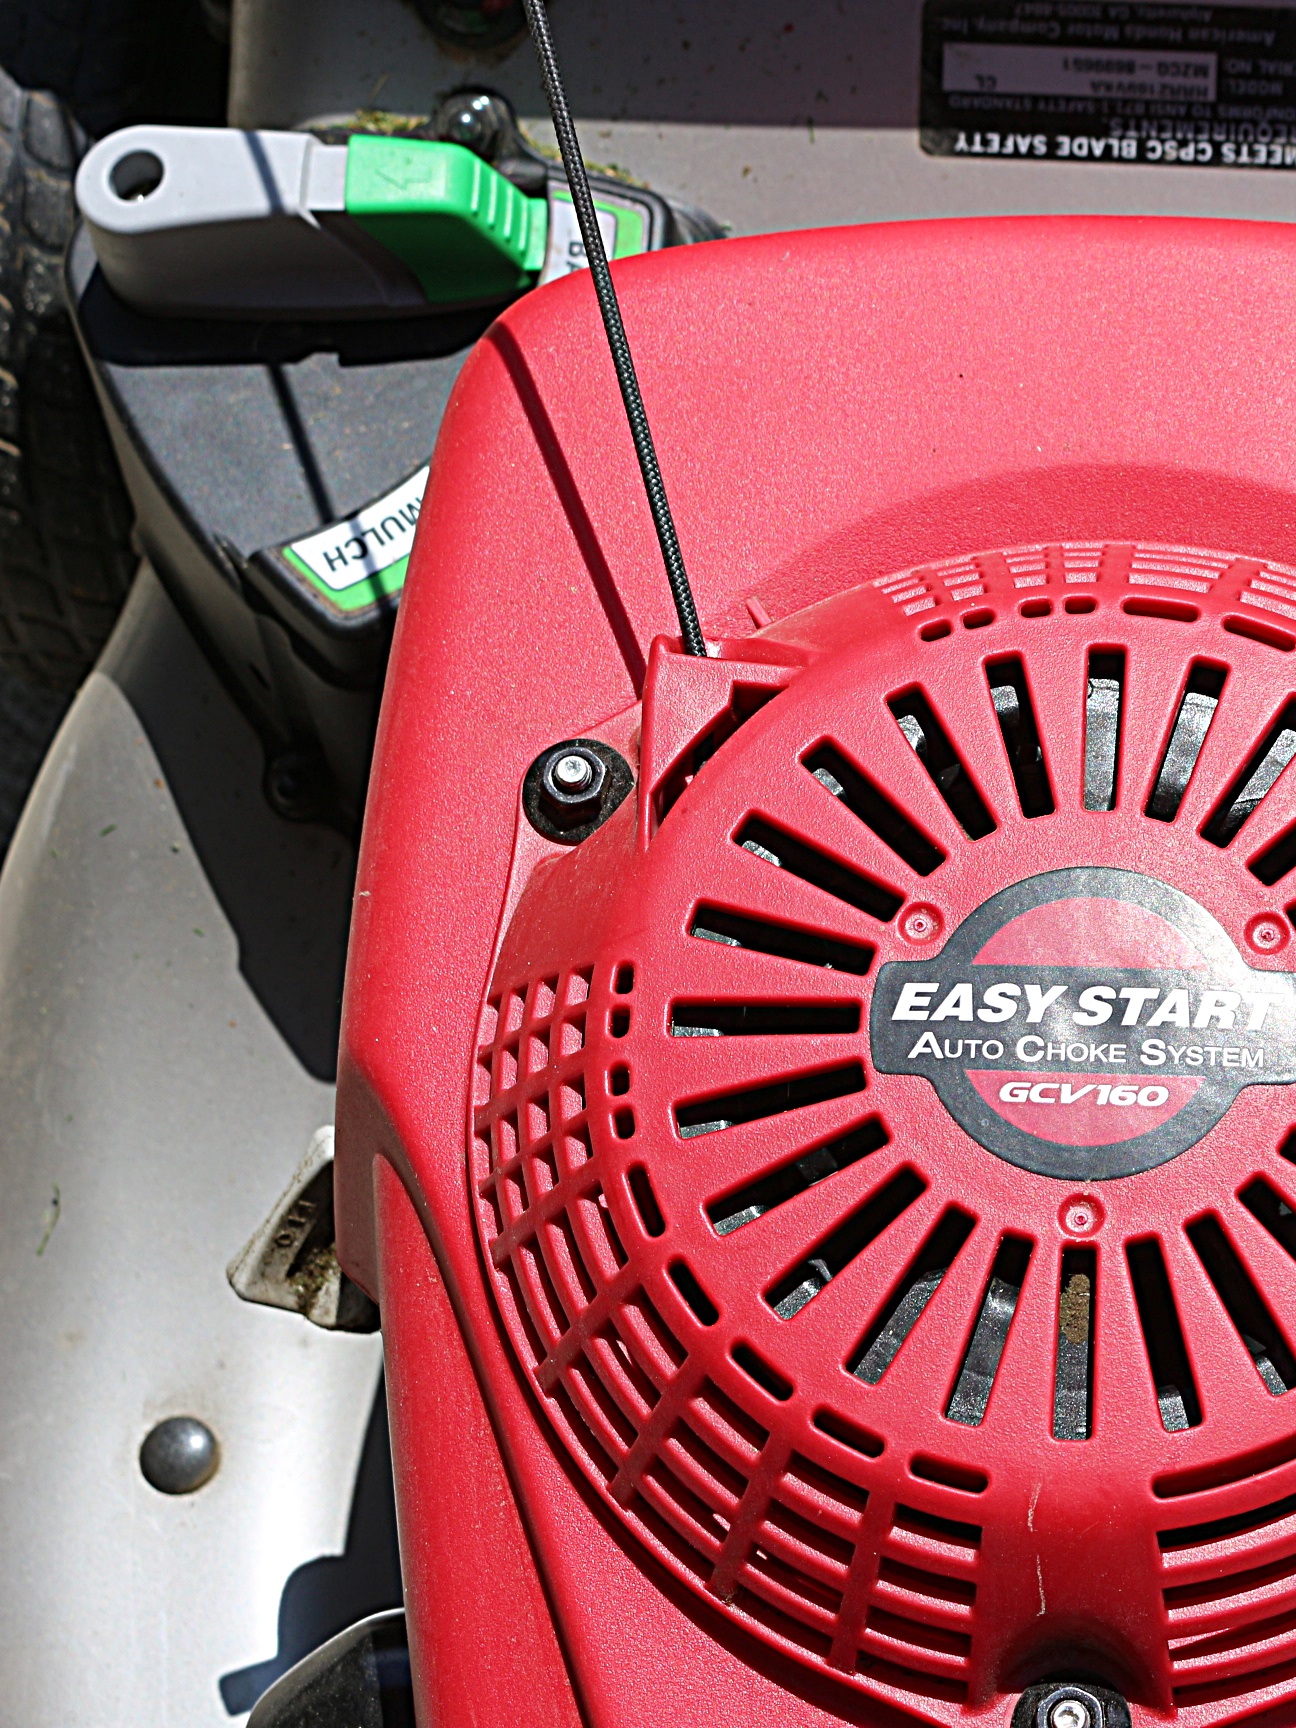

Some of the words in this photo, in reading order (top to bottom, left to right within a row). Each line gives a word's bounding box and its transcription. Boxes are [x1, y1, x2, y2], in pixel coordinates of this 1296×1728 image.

[1067, 22, 1120, 41] Motor
[1124, 24, 1183, 43] Honda
[955, 131, 1047, 155] SAFETY
[1056, 135, 1137, 159] BLADE
[1146, 139, 1213, 162] CPSC
[892, 982, 1068, 1023] EASY
[1074, 985, 1286, 1034] START
[999, 1081, 1169, 1107] GCV160
